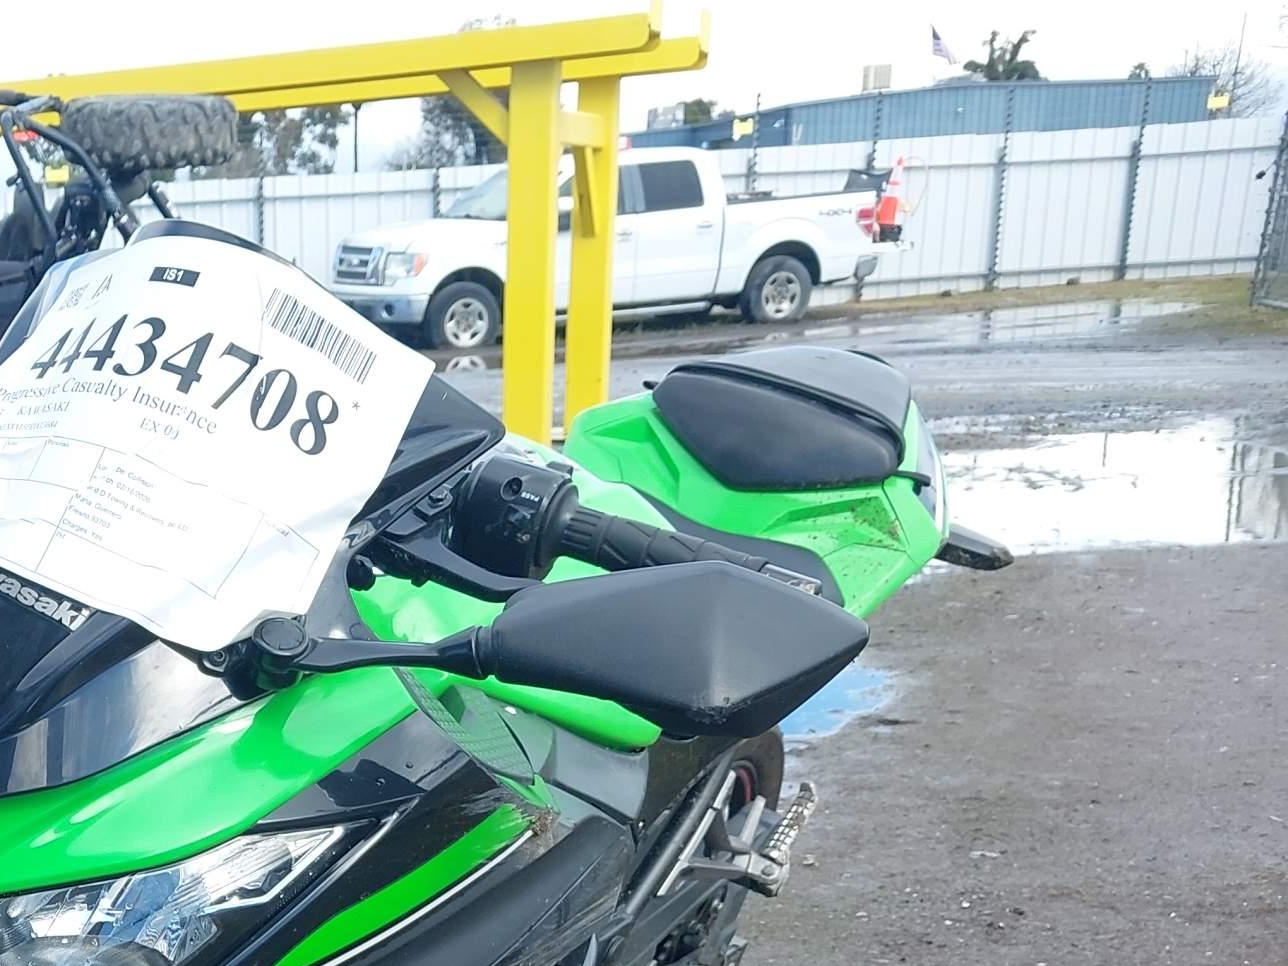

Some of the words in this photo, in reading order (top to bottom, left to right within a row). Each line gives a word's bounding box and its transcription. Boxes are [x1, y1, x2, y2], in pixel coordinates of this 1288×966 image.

[163, 267, 185, 282] IS1
[30, 313, 340, 455] 44434708
[62, 377, 129, 402] Casualty
[133, 386, 217, 434] Insurance
